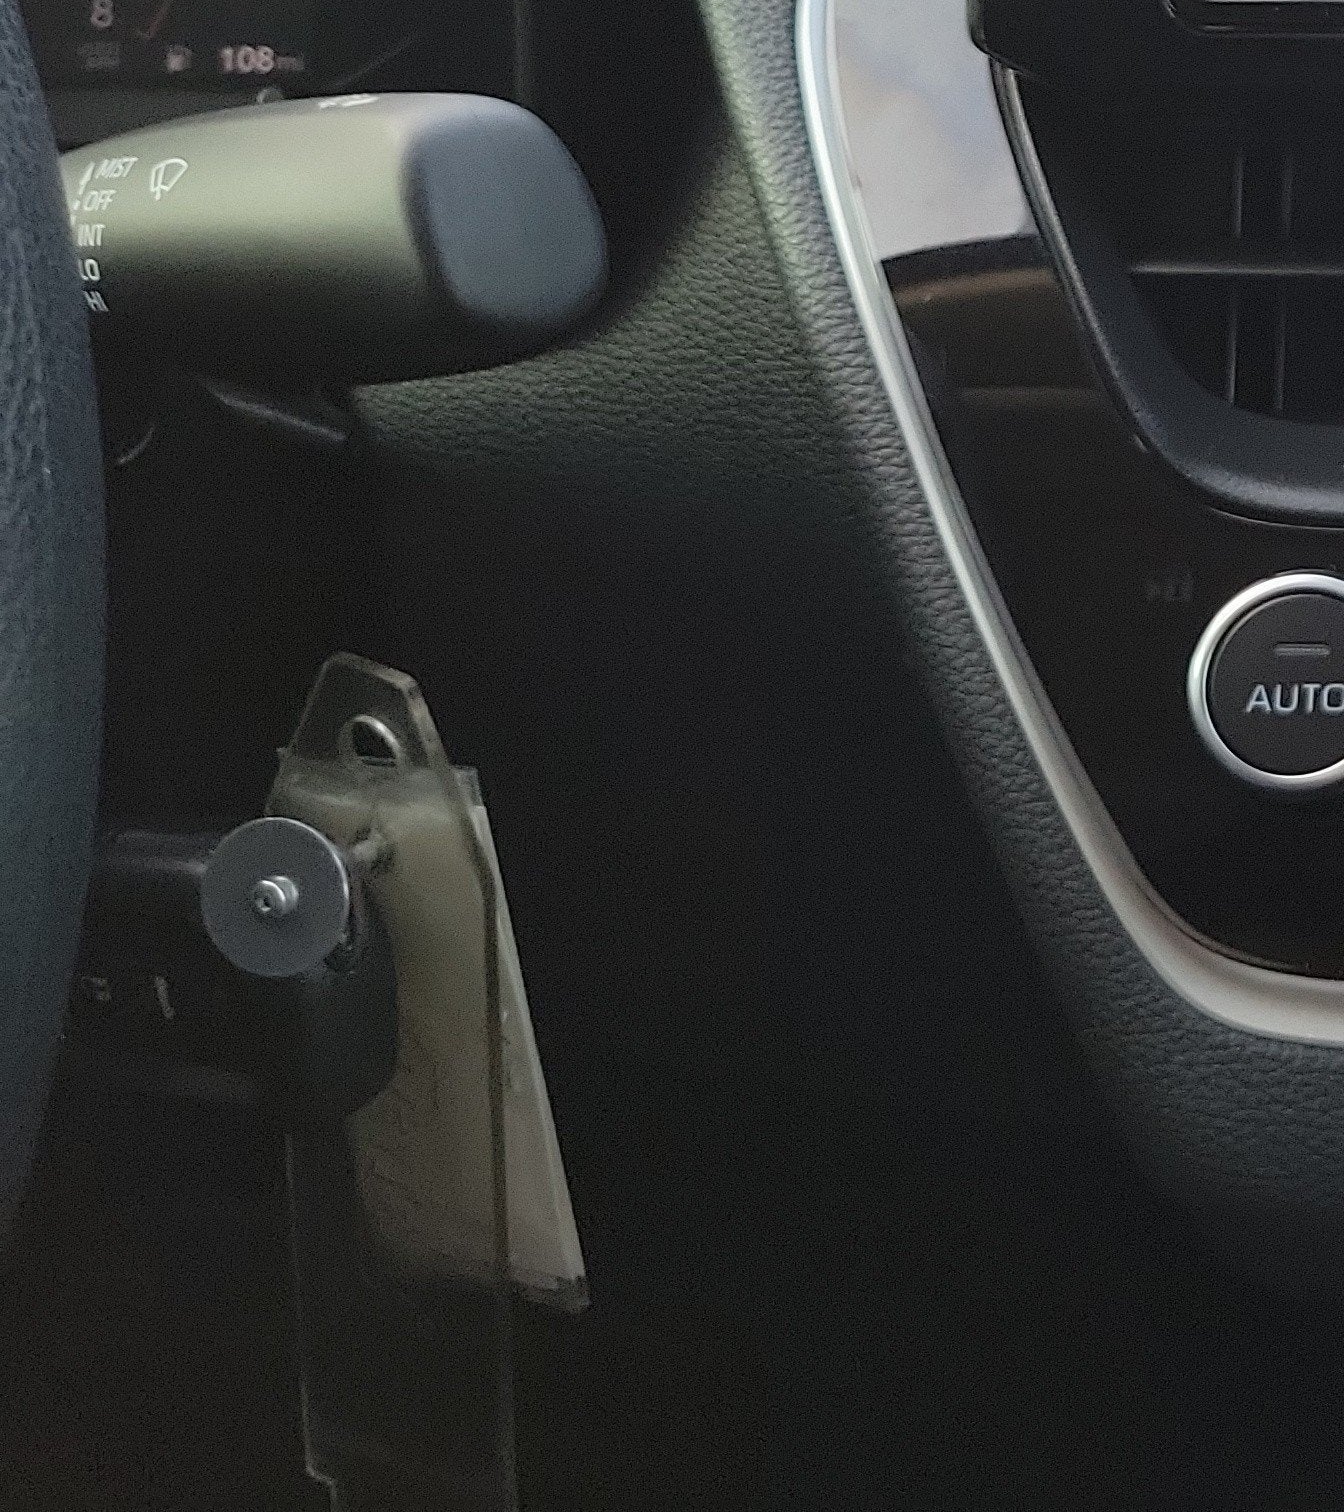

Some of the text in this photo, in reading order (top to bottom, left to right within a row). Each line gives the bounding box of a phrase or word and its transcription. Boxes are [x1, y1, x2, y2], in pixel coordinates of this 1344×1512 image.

[218, 44, 275, 74] 108
[95, 157, 139, 179] MIST
[83, 190, 117, 211] OFF
[78, 258, 101, 281] LO
